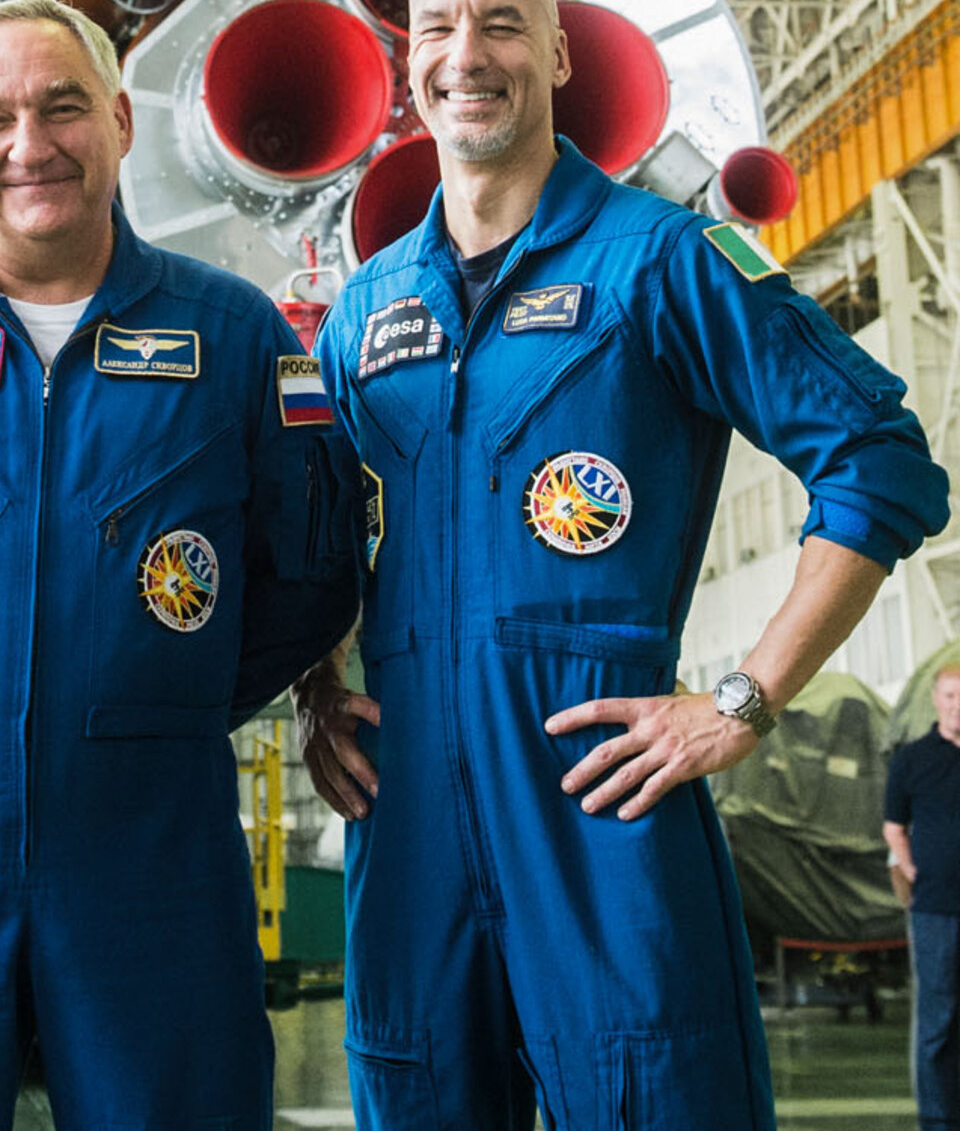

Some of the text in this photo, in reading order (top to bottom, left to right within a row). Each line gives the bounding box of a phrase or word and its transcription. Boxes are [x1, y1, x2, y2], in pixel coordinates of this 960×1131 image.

[389, 318, 425, 338] esa
[577, 464, 617, 501] LXI
[184, 543, 211, 580] LXI
